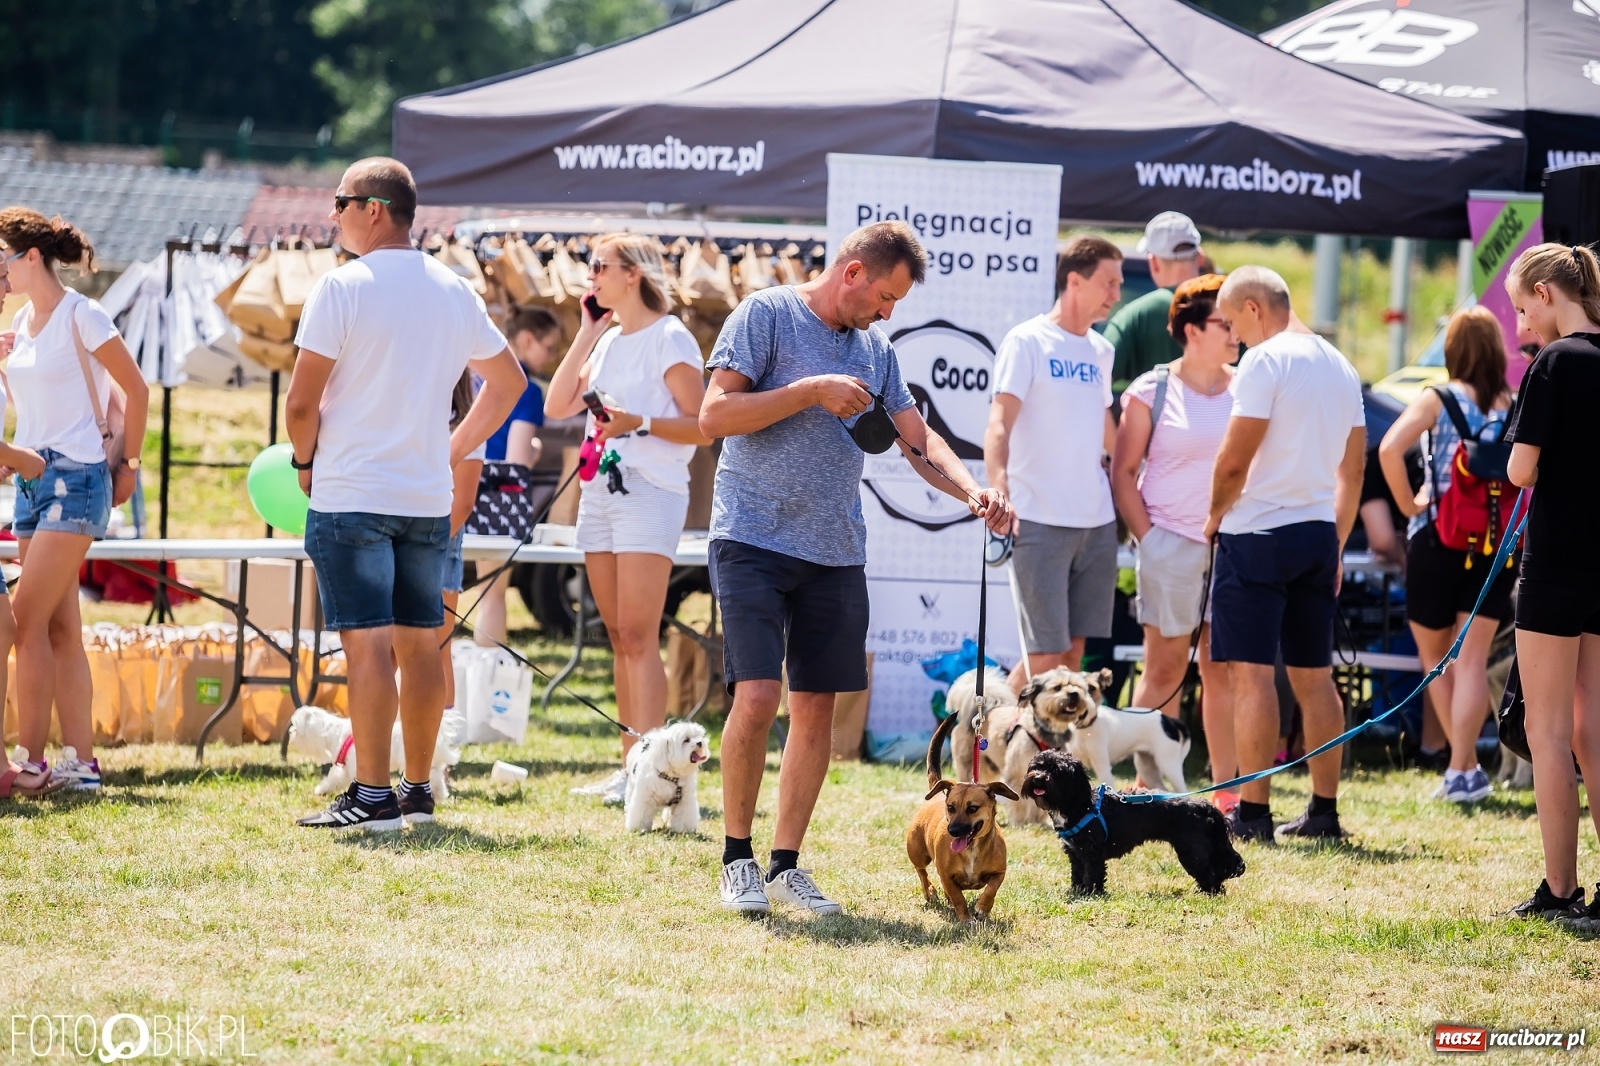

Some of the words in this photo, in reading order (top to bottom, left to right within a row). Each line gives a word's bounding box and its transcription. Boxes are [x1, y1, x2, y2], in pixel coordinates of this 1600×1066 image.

[1377, 77, 1499, 99] STAGE
[554, 134, 765, 177] www.raciborz.pl
[1135, 157, 1362, 205] www.raciborz.pl
[986, 253, 1038, 277] psa
[931, 357, 989, 391] Coco
